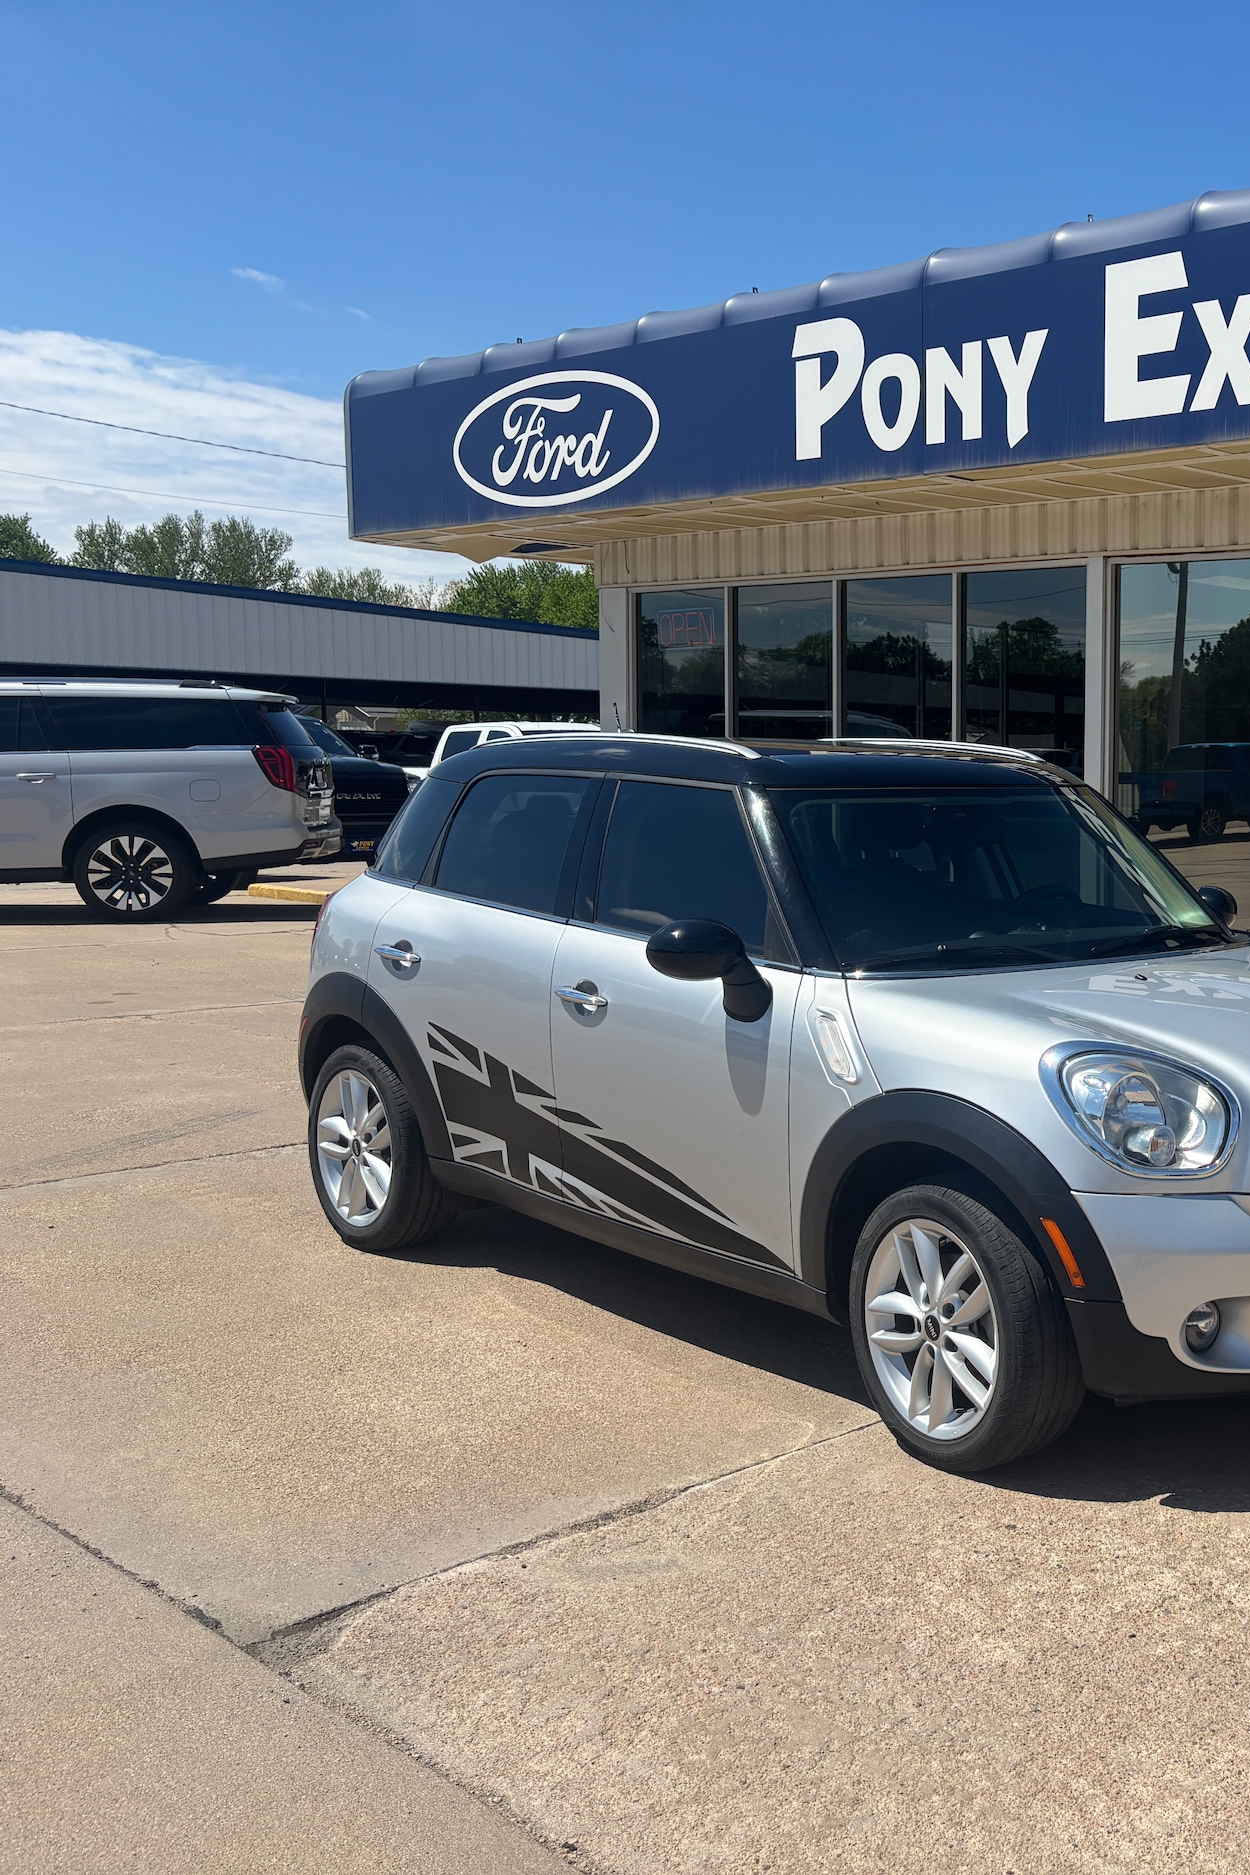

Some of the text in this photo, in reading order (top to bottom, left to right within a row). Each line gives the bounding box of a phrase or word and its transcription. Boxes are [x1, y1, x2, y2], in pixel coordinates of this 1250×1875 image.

[791, 317, 1049, 460] PONY
[492, 393, 614, 486] Ford
[660, 611, 713, 646] OPEN
